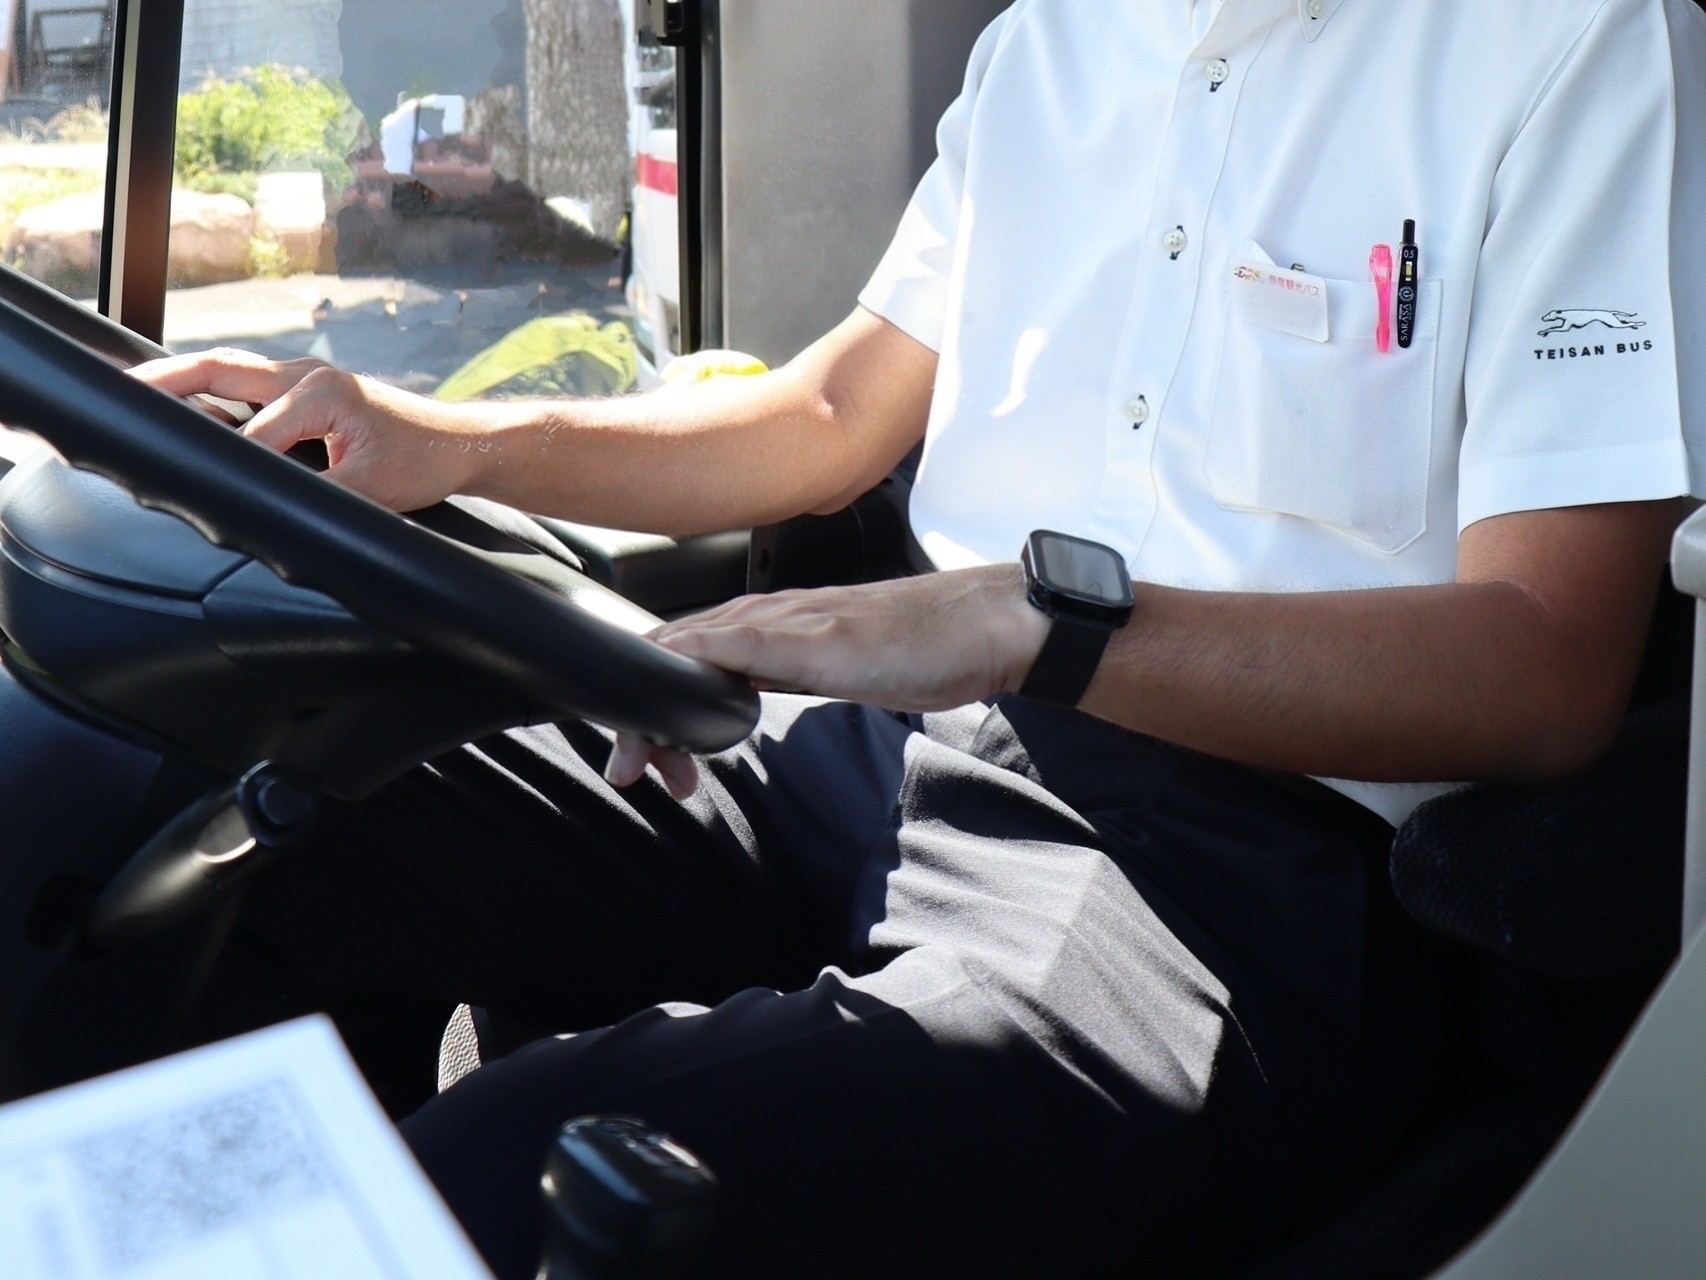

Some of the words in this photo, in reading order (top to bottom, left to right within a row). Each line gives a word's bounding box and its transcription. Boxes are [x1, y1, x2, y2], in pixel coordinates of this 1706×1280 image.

[1403, 249, 1415, 259] 0.5
[1400, 303, 1410, 341] SARASA
[1534, 345, 1605, 360] TEISAN
[1616, 340, 1652, 354] BUS
